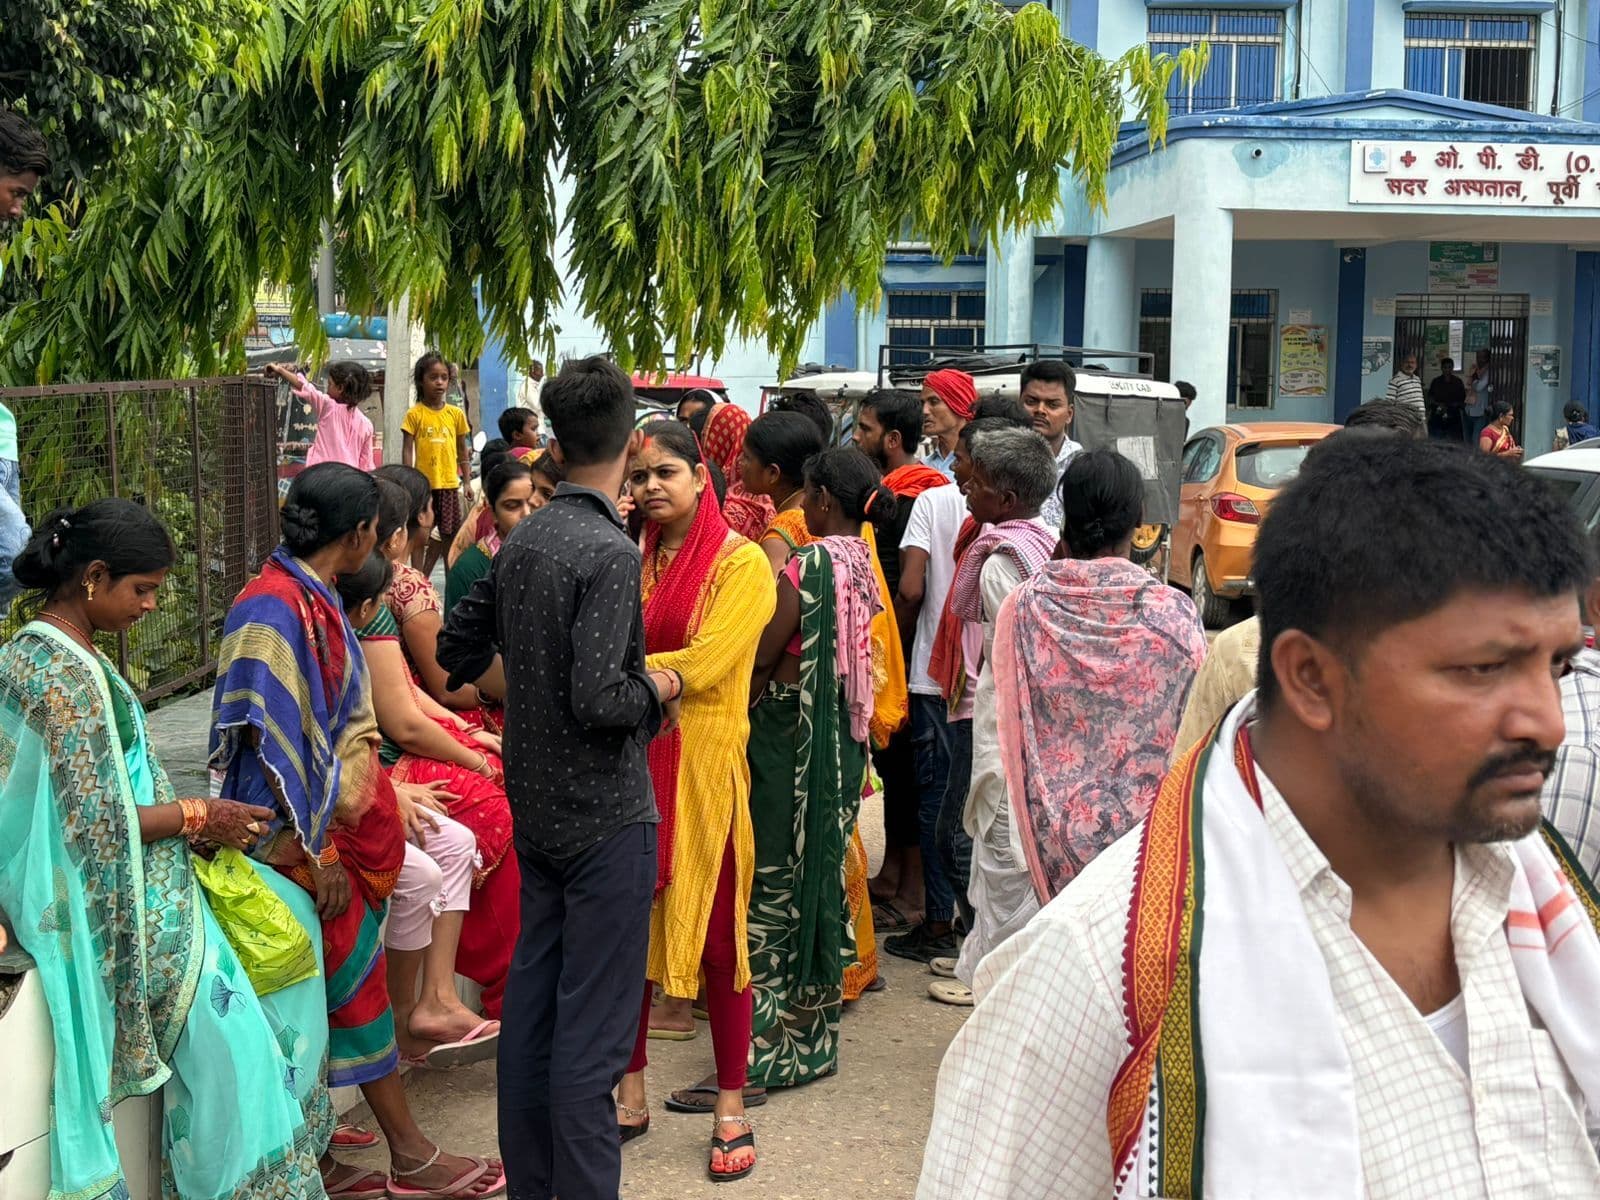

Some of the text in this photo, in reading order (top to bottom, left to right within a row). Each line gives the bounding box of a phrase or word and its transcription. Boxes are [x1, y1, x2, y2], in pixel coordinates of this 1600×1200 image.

[1434, 145, 1464, 170] ओ.
[1477, 145, 1502, 170] पी.
[1516, 146, 1544, 172] डी.
[1385, 178, 1428, 197] सदर
[1444, 178, 1528, 202] अस्पताल,
[1547, 174, 1581, 205] पूर्वी
